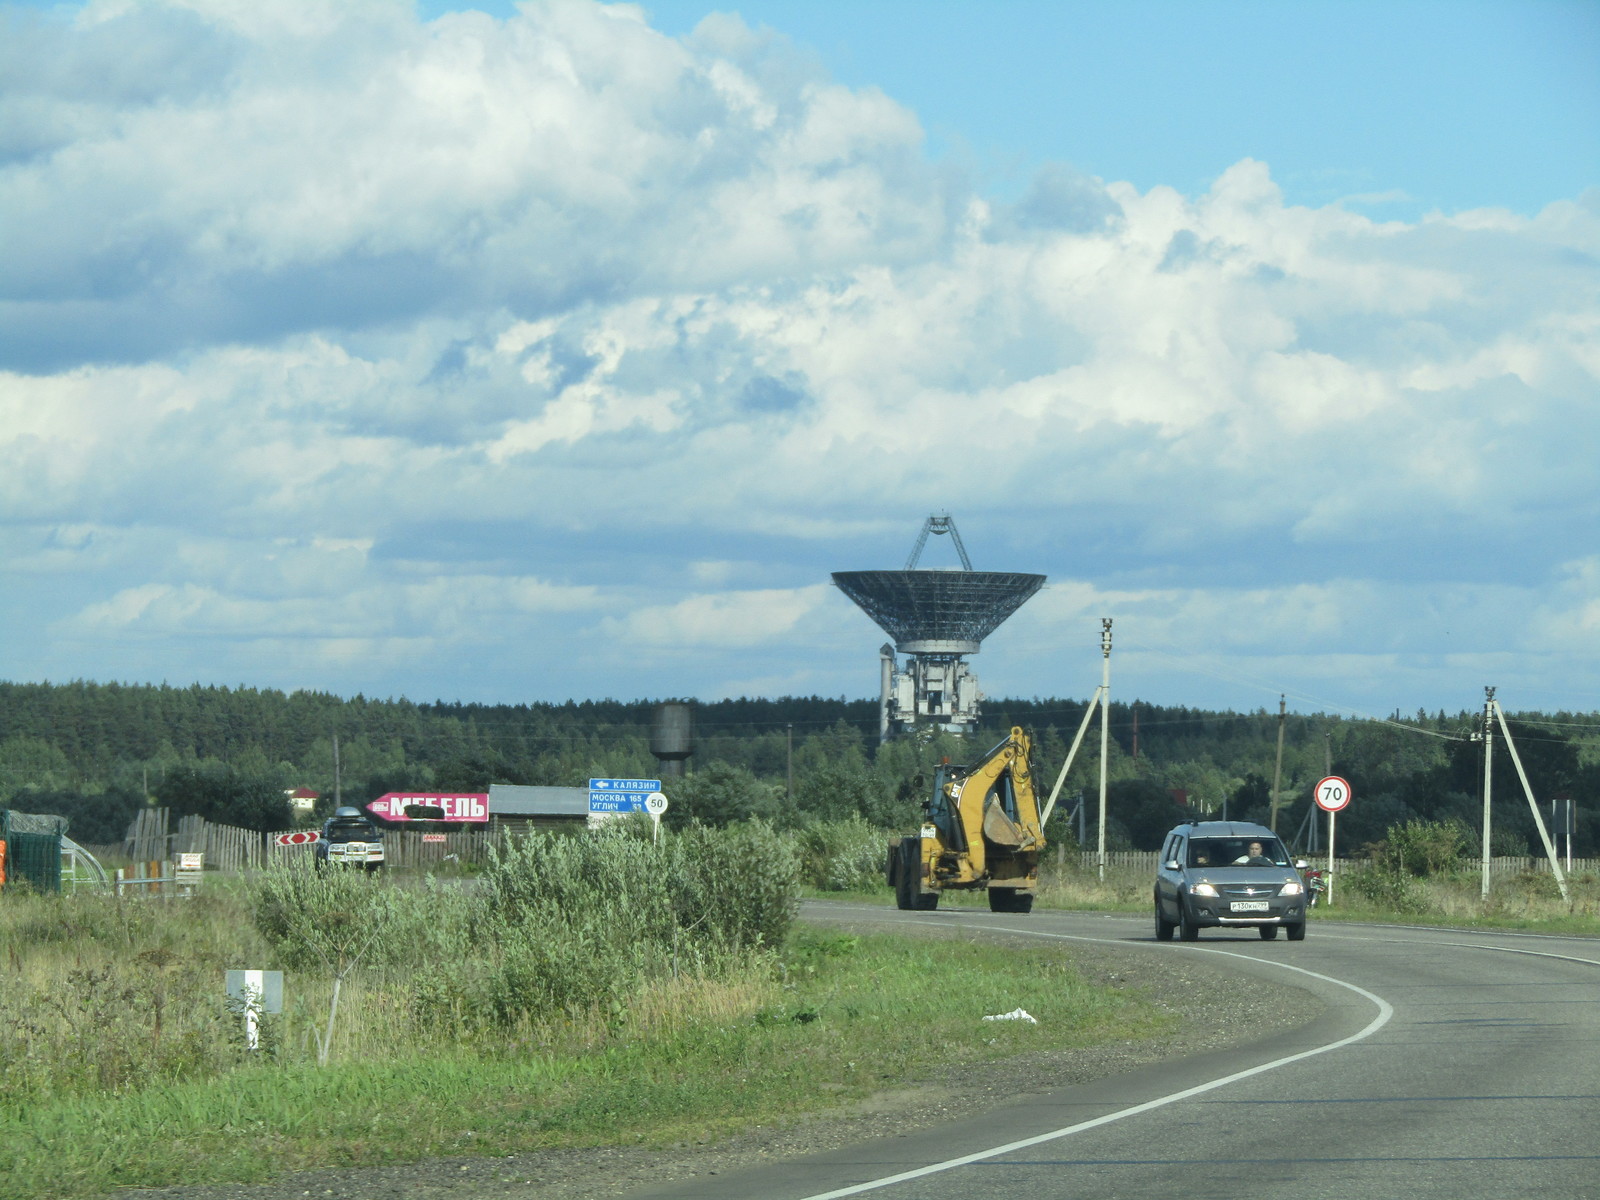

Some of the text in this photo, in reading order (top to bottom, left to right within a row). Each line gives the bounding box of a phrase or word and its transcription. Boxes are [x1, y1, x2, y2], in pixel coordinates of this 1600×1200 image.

[613, 781, 656, 789] КАЛЯЗИН
[951, 783, 961, 797] CAT
[1323, 786, 1342, 801] 70
[592, 794, 626, 802] МОСКВА
[592, 802, 619, 810] УГЛИЧ
[650, 799, 663, 808] 50
